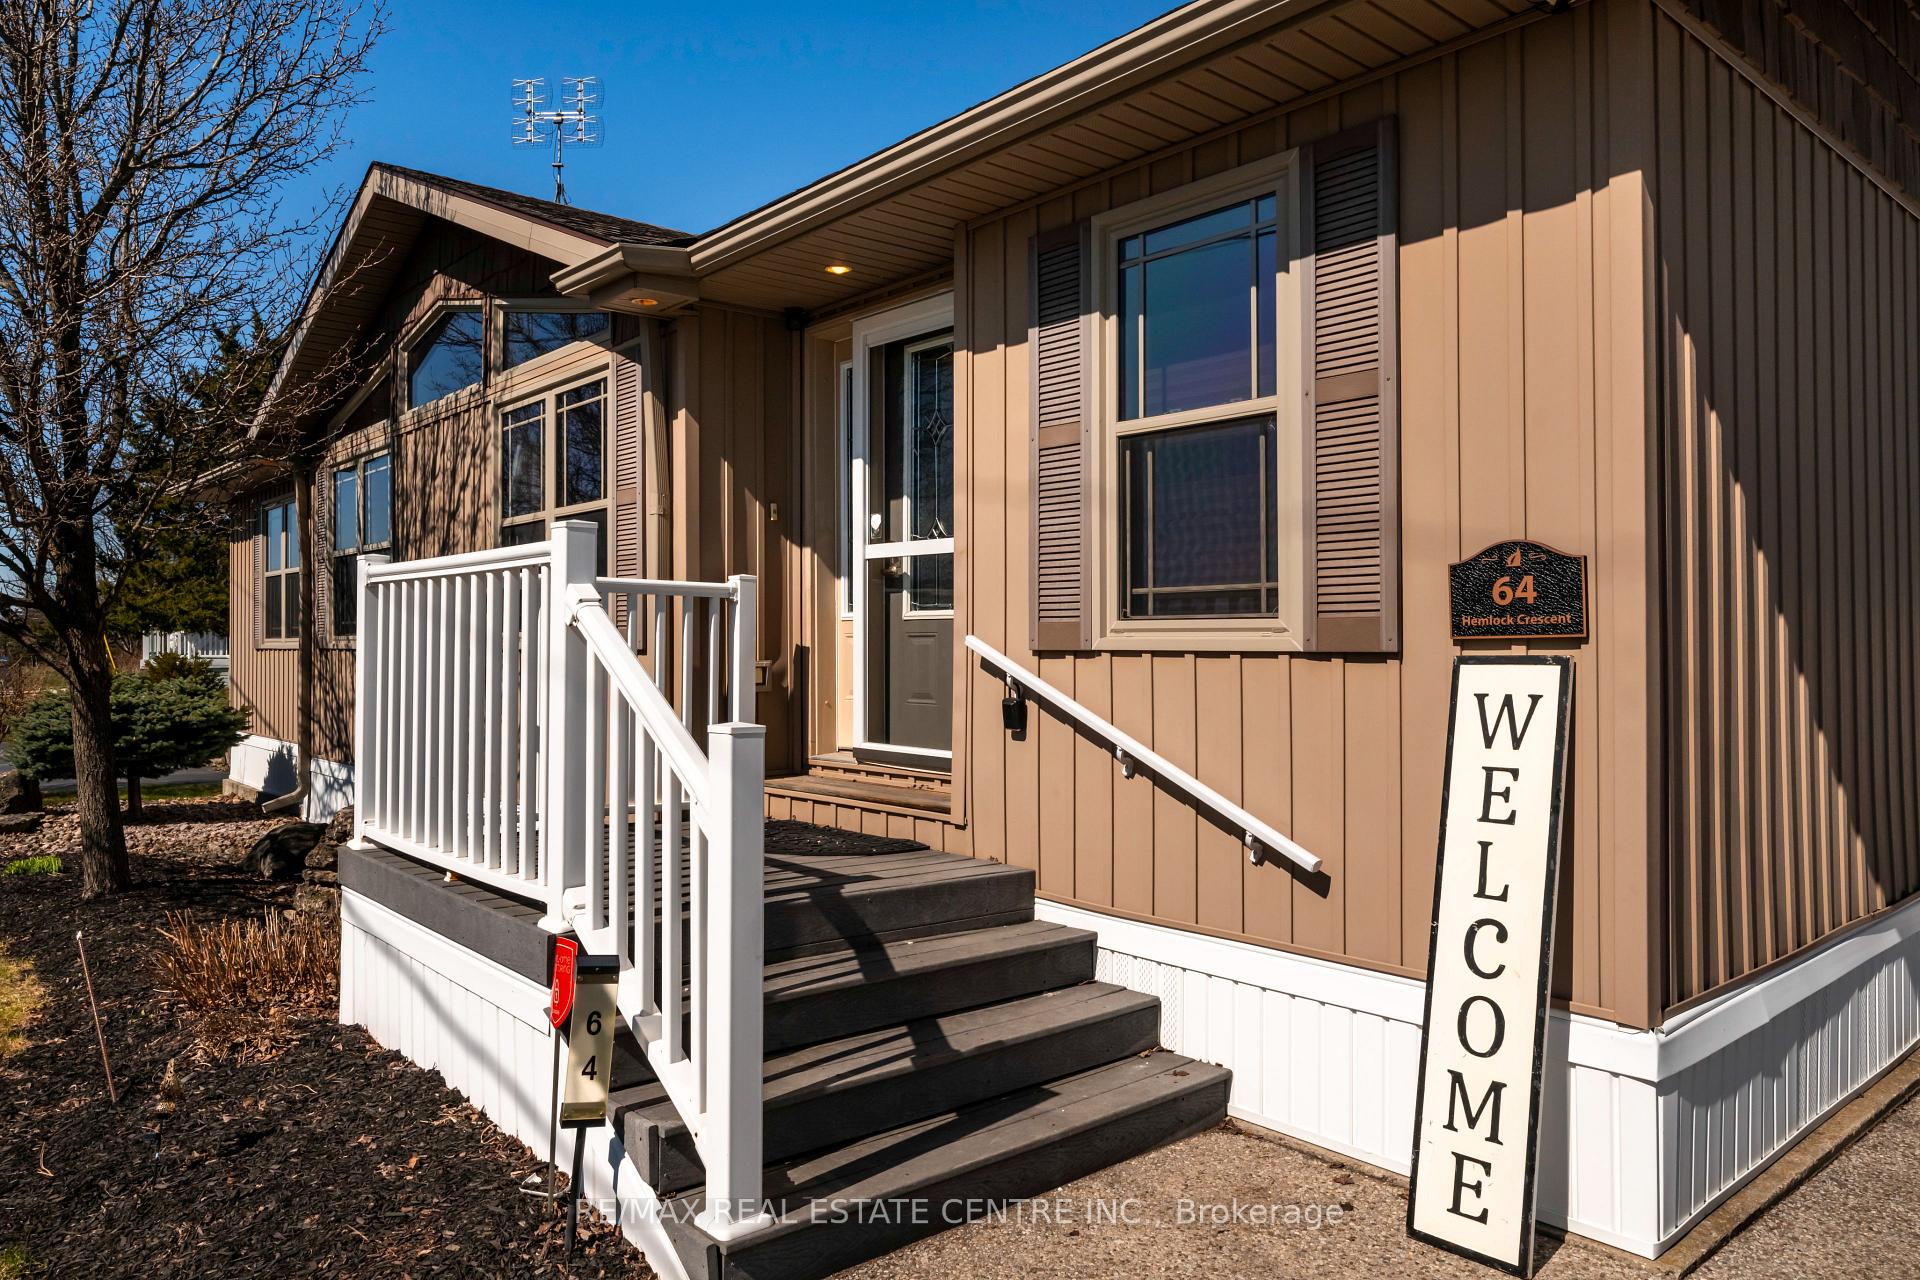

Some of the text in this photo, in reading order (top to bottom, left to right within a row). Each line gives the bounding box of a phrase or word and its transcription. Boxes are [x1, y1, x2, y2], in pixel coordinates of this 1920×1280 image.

[1491, 575, 1537, 606] 64
[1462, 612, 1572, 627] Hemlock Crescent
[1442, 692, 1544, 1226] WELCOME
